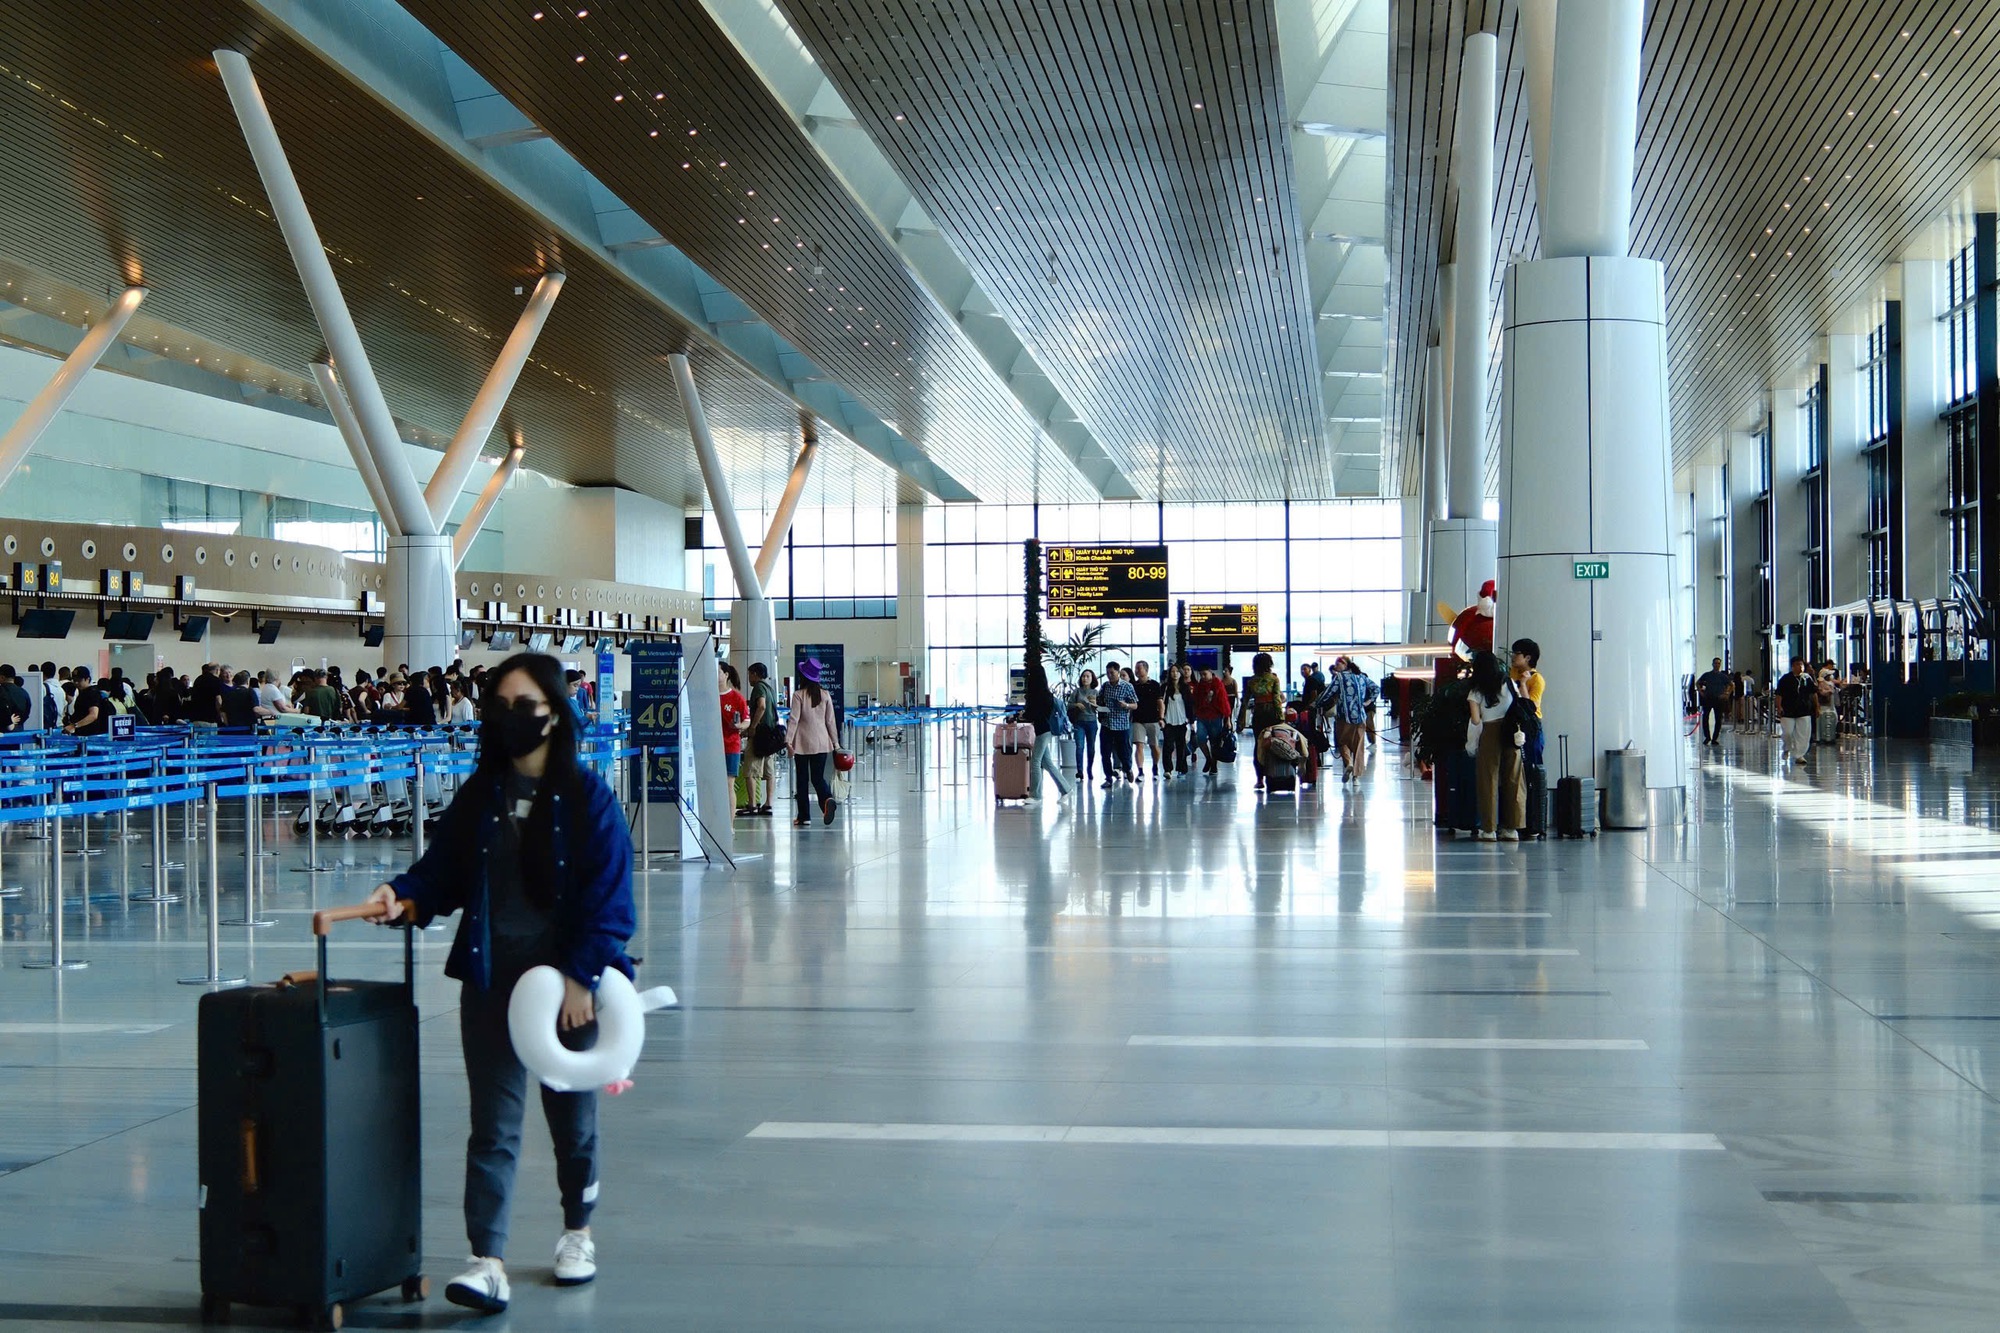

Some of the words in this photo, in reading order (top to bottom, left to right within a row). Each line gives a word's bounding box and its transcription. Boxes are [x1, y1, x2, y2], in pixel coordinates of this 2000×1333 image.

[24, 569, 34, 584] 83
[1128, 566, 1167, 579] 80-99
[1576, 564, 1600, 577] EXIT
[50, 572, 59, 587] 84
[110, 575, 119, 589] 85
[132, 578, 141, 591] 86
[185, 581, 192, 593] 87
[637, 702, 678, 729] 40
